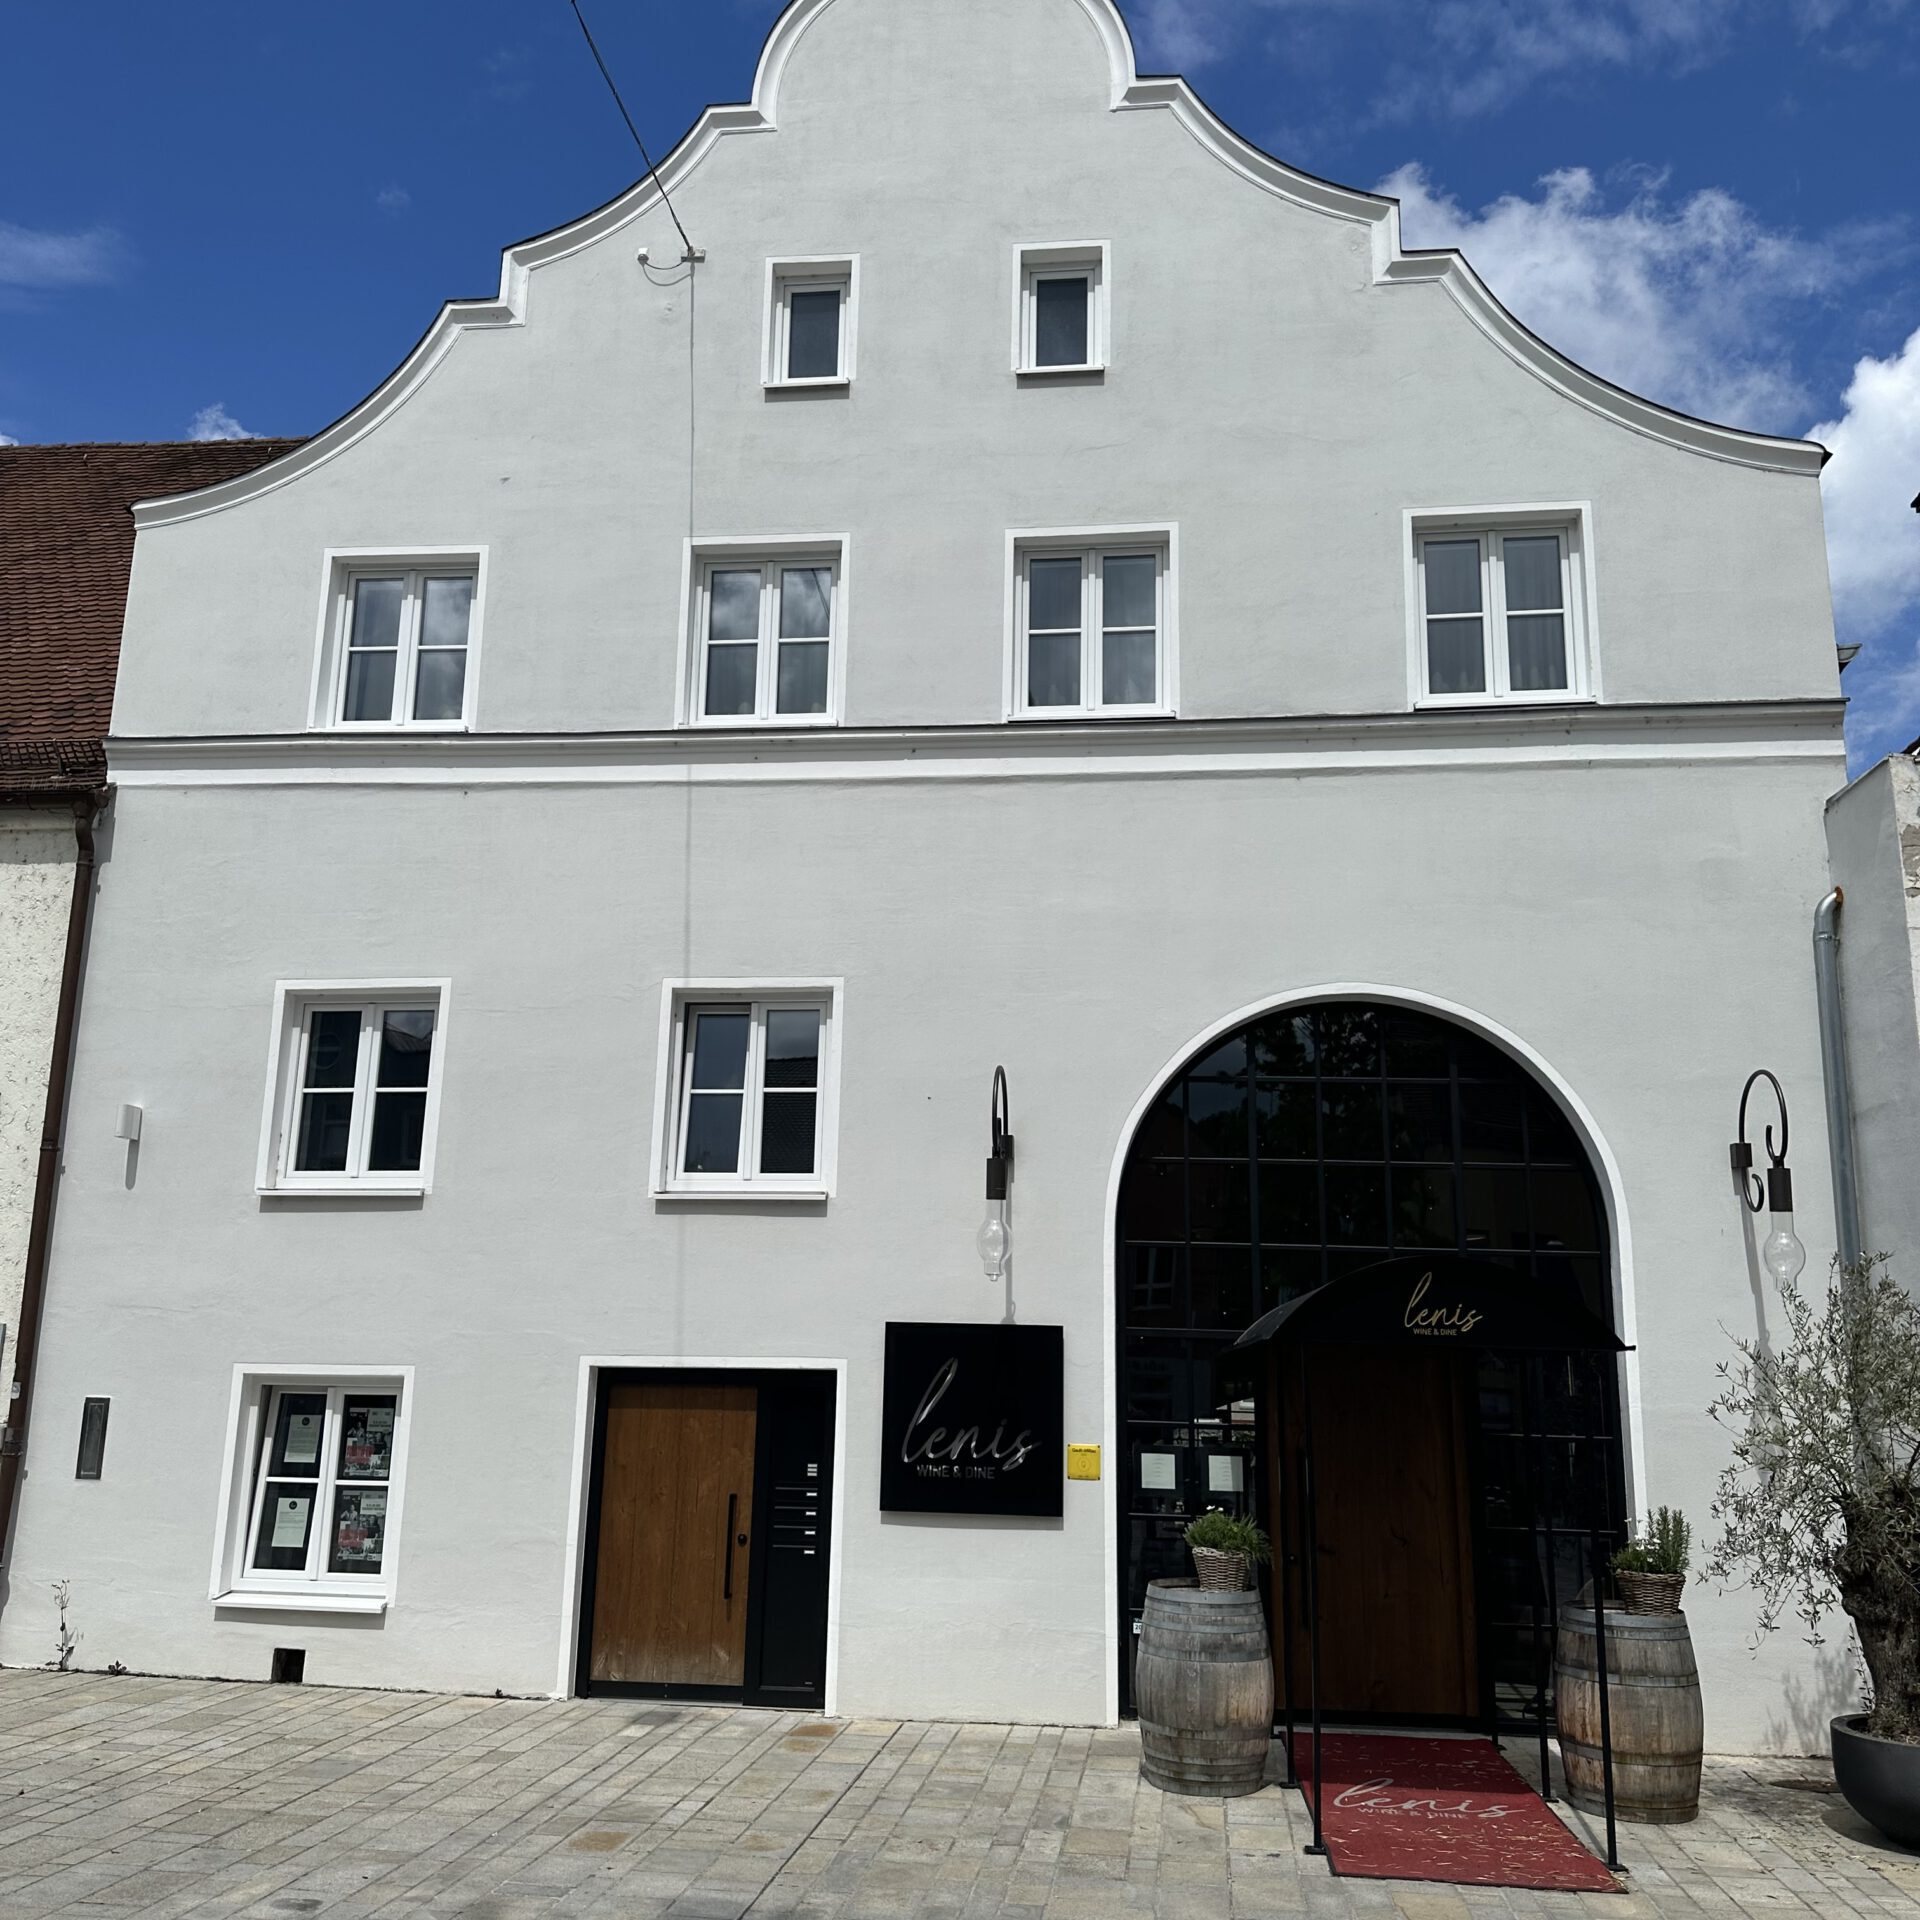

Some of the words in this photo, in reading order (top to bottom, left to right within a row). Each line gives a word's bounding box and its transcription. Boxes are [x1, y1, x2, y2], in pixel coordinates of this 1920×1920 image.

[1404, 1272, 1483, 1332] lenis
[1413, 1328, 1433, 1336] WINE
[1433, 1328, 1440, 1336] &
[1440, 1328, 1458, 1336] DINE
[901, 1357, 1044, 1472] lenis
[916, 1464, 950, 1478] WINE
[953, 1464, 962, 1479] &
[965, 1466, 997, 1480] DINE
[1333, 1778, 1526, 1818] lenis
[1357, 1808, 1403, 1816] WINE
[1427, 1811, 1469, 1819] DINE
